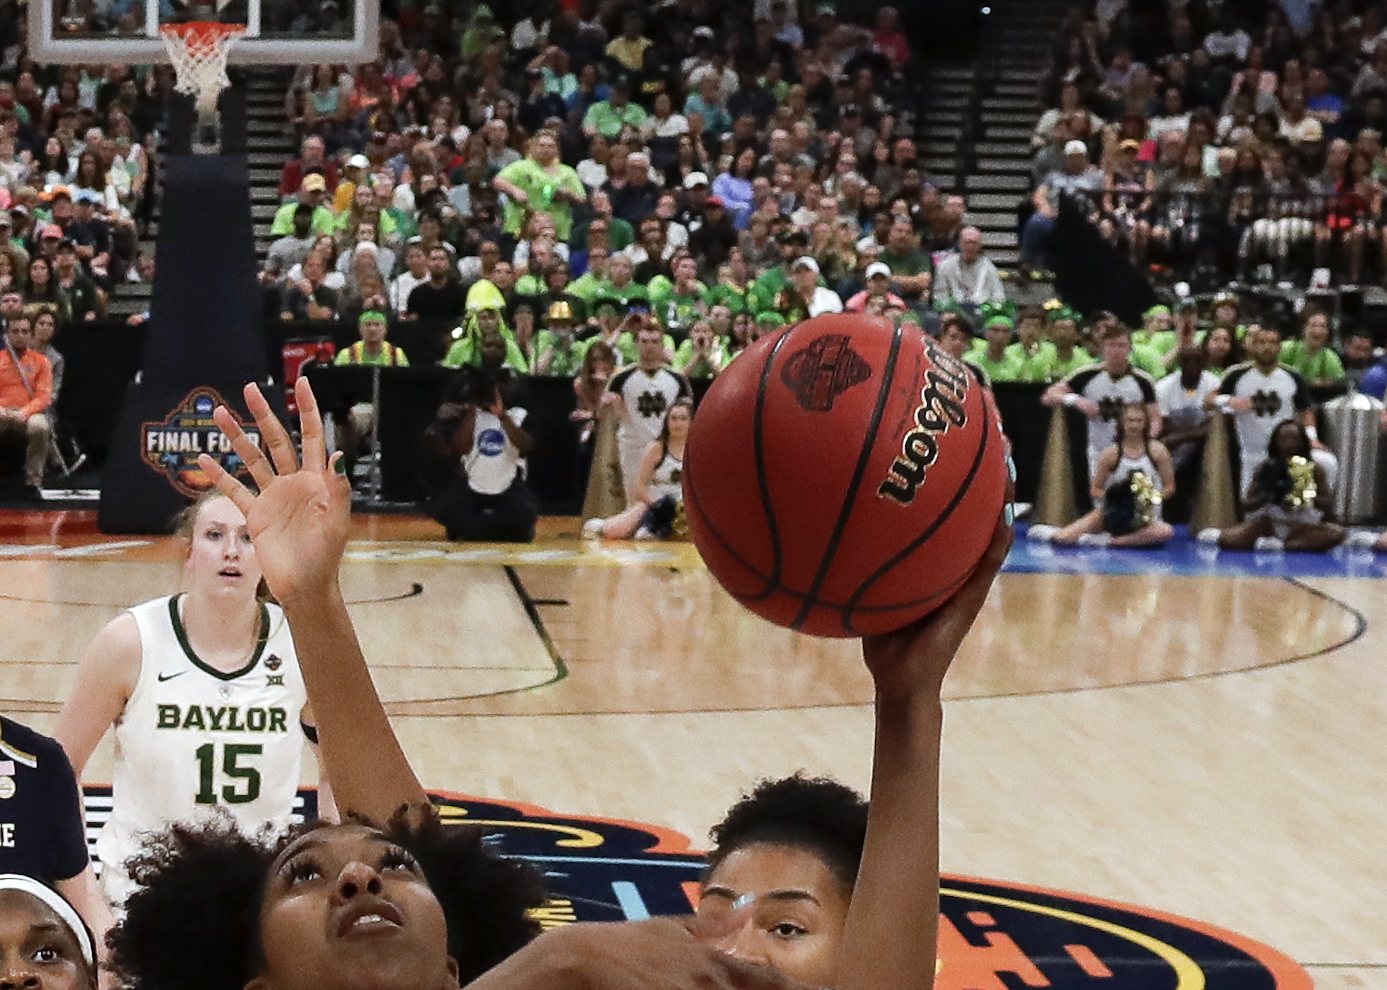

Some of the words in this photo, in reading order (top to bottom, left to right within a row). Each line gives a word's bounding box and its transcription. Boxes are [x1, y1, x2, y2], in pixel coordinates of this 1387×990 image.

[147, 431, 202, 453] FINAL
[207, 432, 261, 452] FOR
[876, 336, 970, 507] Wilson
[156, 703, 287, 733] BAYLOR
[194, 743, 263, 804] 15
